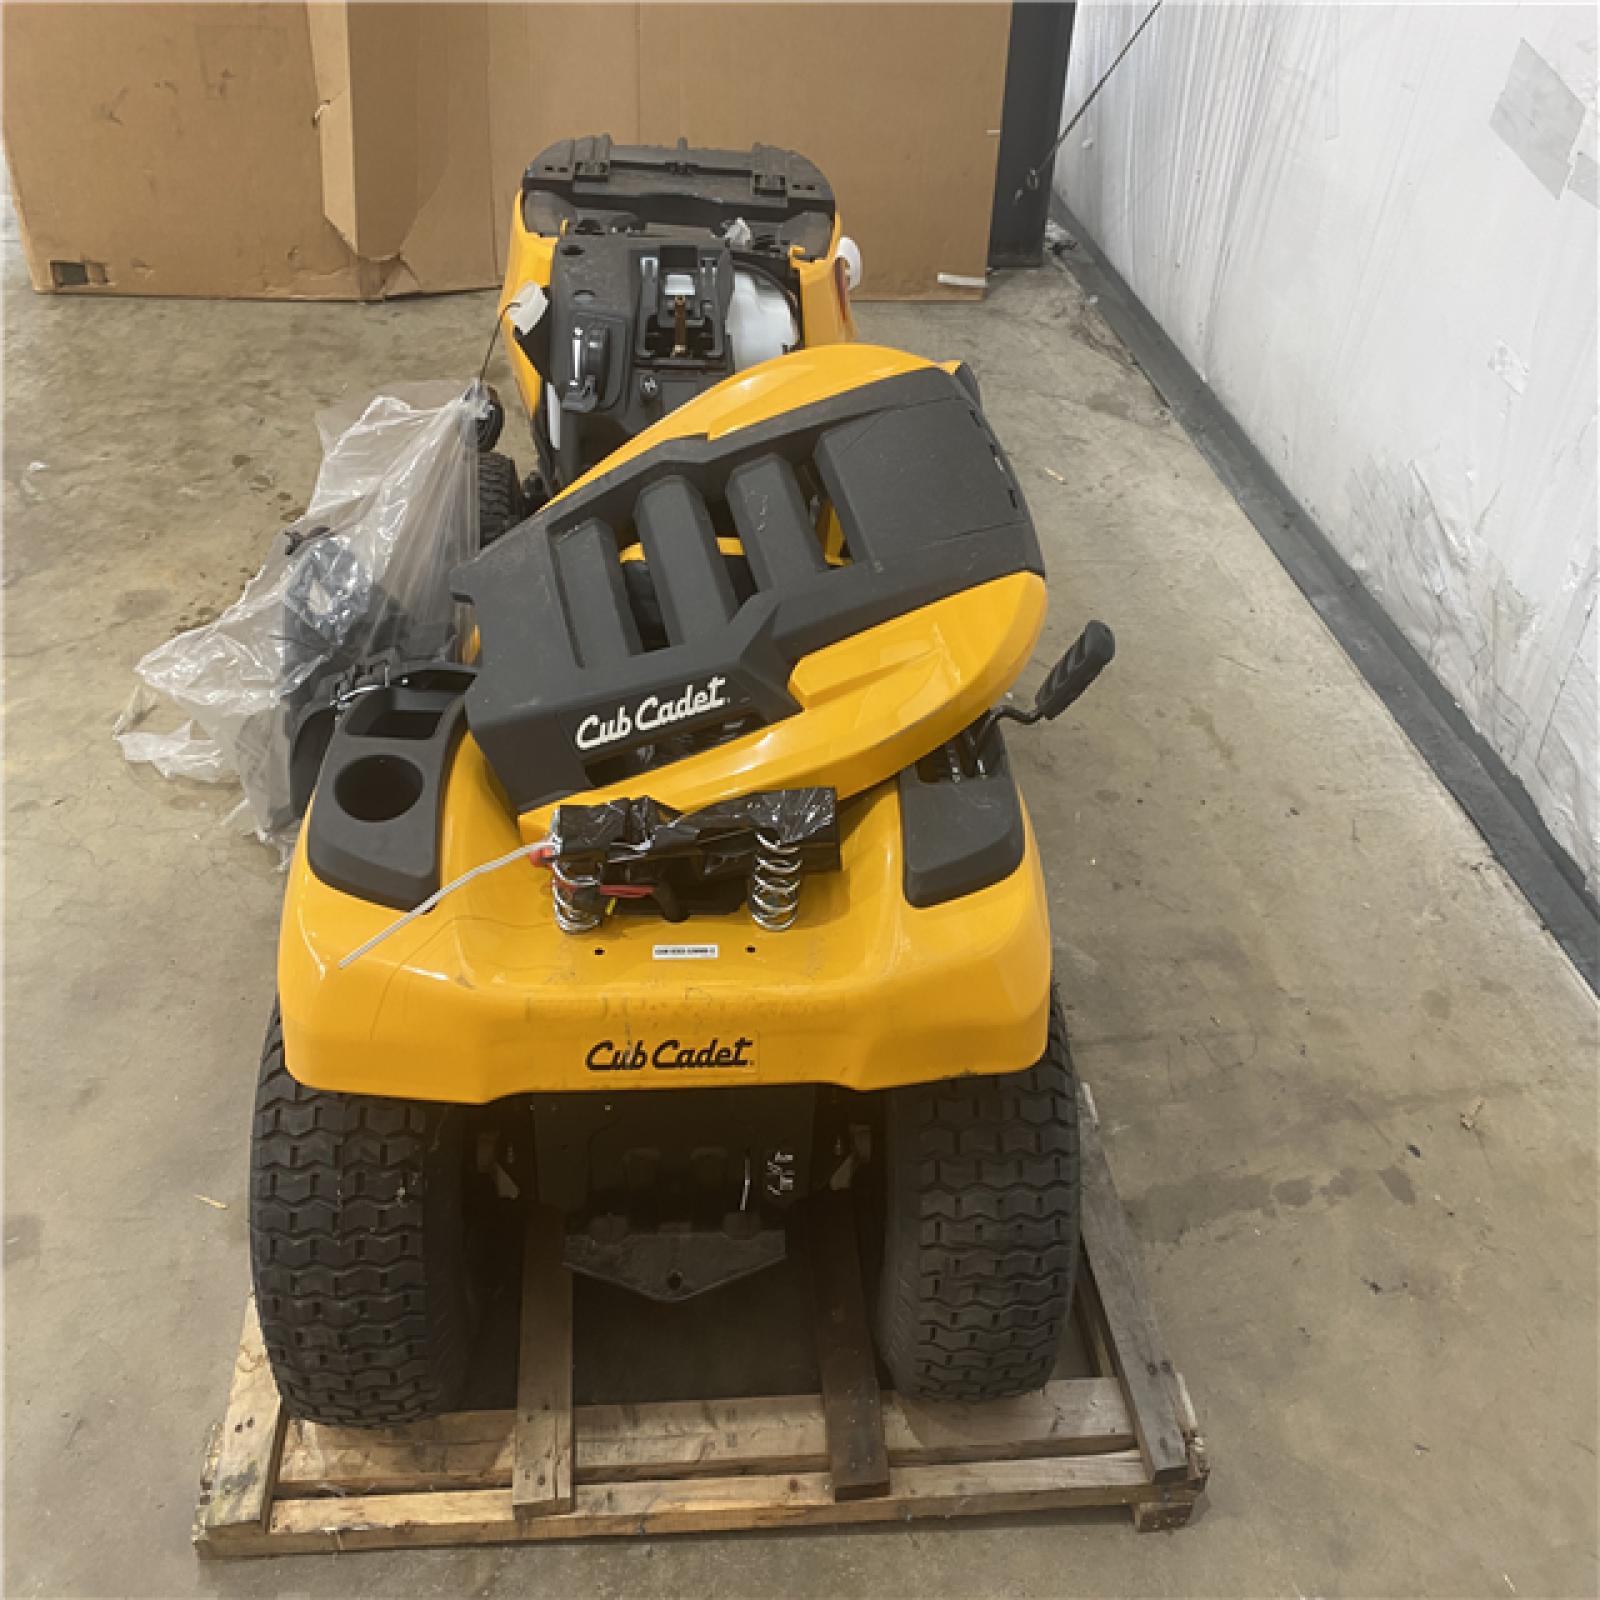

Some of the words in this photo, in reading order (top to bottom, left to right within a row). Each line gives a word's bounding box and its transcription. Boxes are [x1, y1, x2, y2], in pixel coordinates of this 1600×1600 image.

[575, 705, 632, 750] Cub
[635, 676, 726, 731] Cadet
[586, 1040, 648, 1071] Cub
[652, 1037, 753, 1068] Cadet
